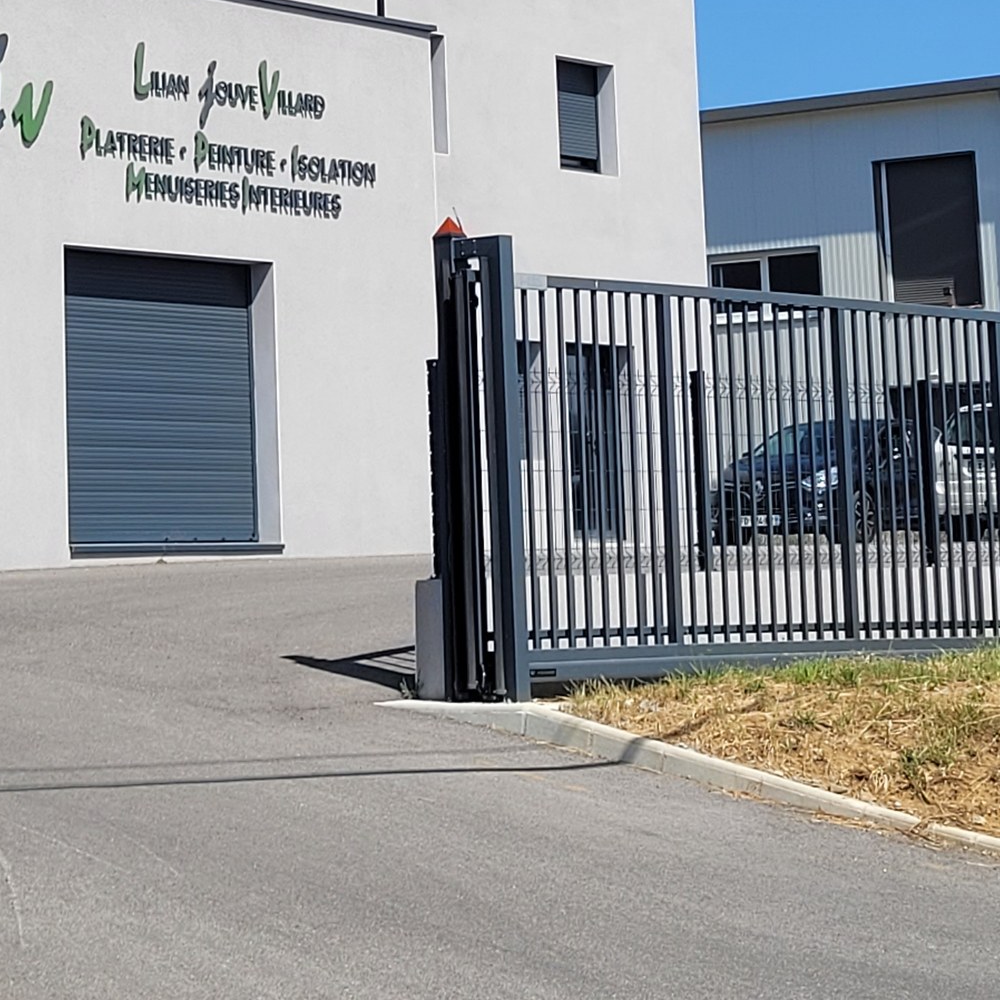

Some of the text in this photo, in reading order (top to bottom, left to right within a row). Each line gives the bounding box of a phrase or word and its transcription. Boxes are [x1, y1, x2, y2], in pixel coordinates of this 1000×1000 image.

[133, 41, 189, 101] LILIAN
[259, 60, 325, 120] VILLARD
[80, 115, 376, 188] PLATRERIE PEINTURE ISOLATION
[126, 162, 342, 220] MENUISERIES INTERIEURES
